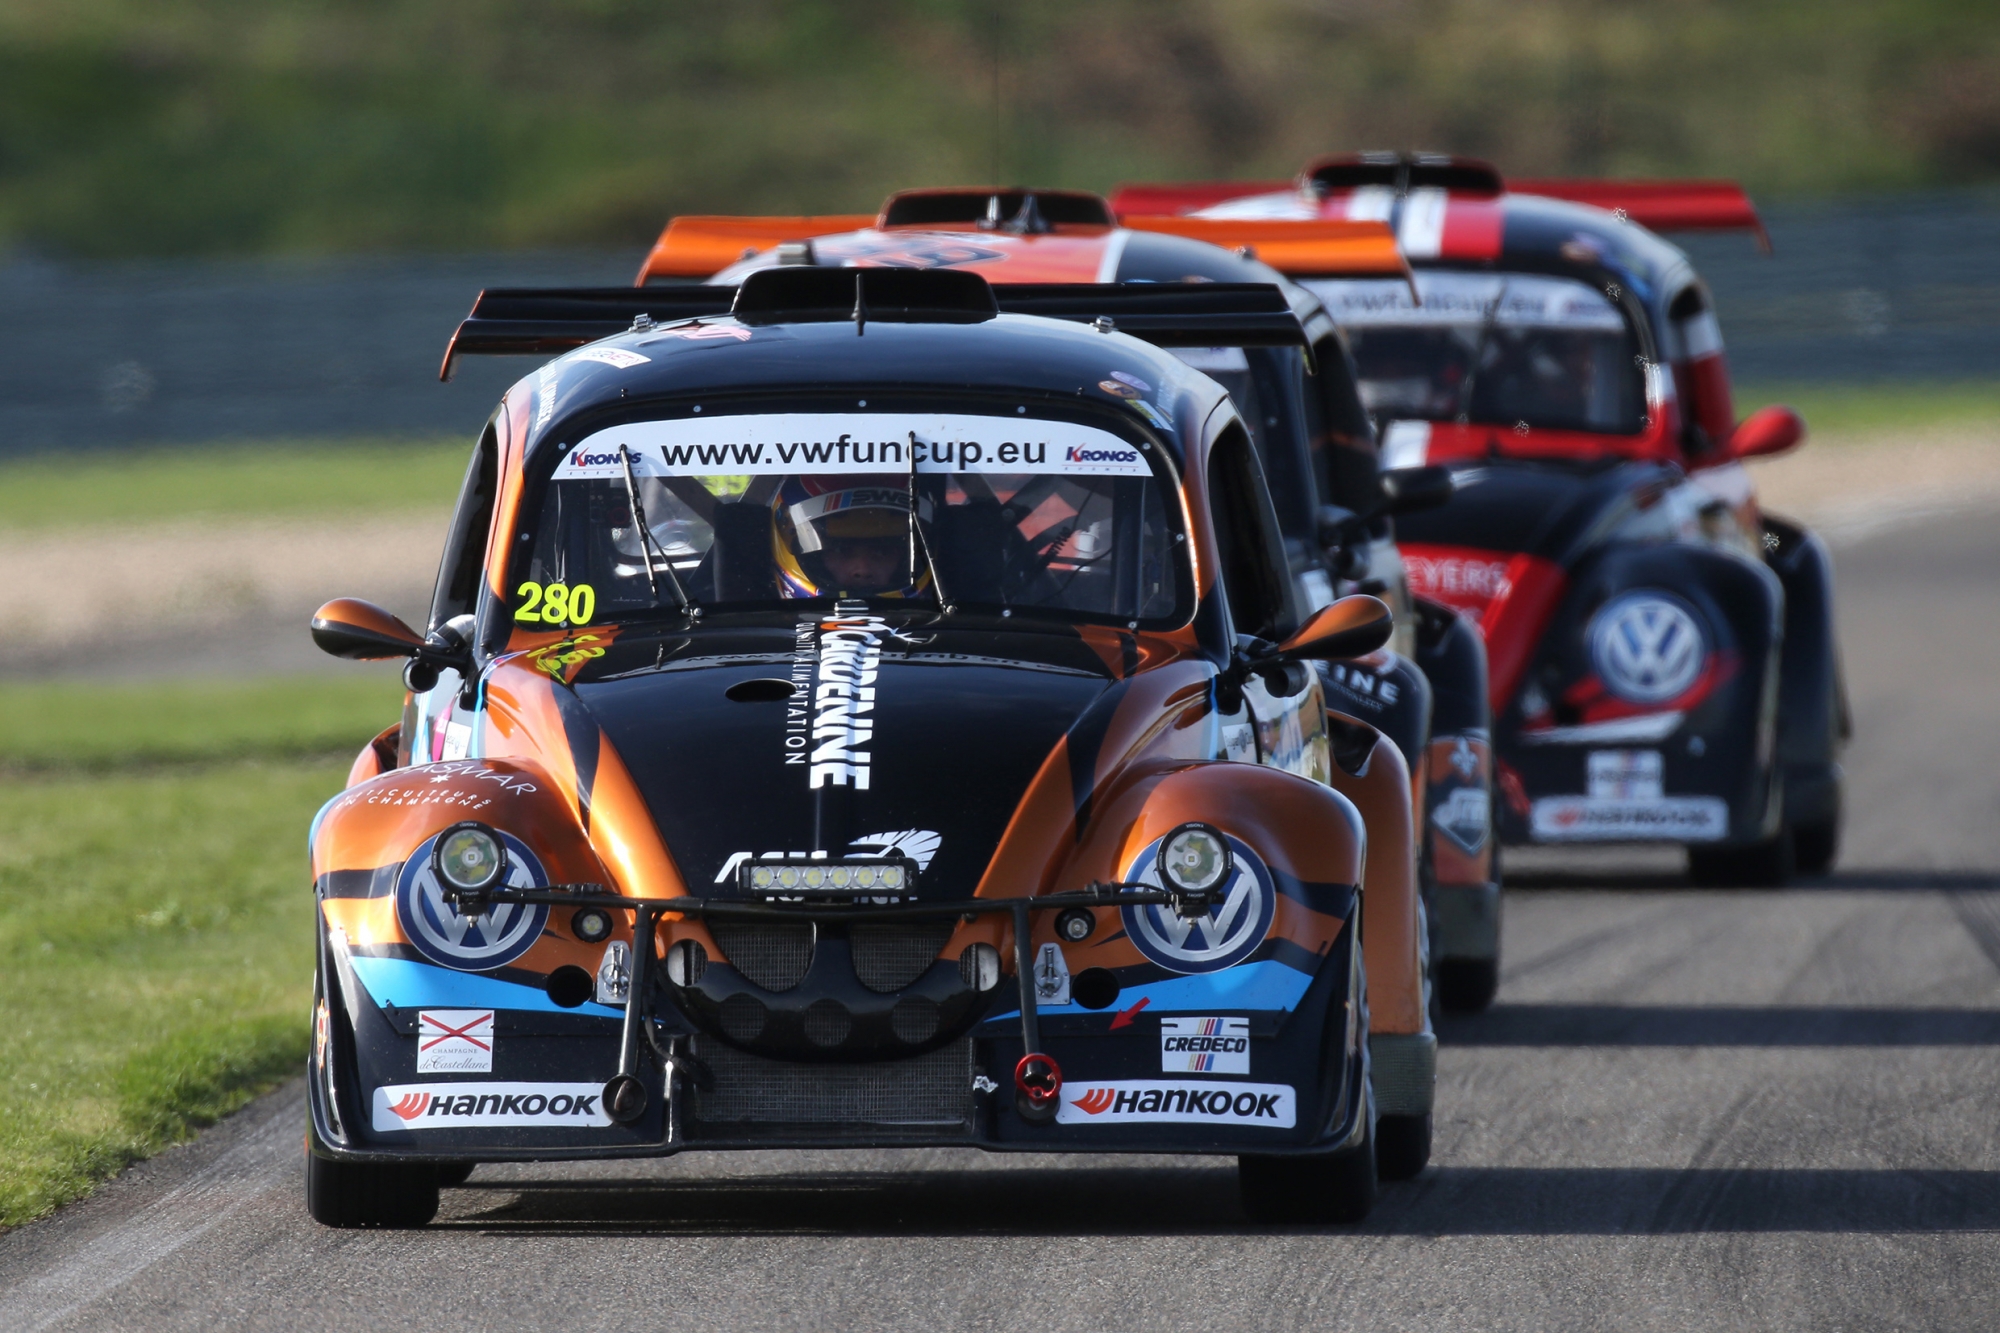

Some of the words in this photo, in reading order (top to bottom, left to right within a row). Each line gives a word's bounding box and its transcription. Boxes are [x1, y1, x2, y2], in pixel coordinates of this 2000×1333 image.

[661, 434, 1046, 471] www.vwfuncup.eu
[1065, 442, 1138, 463] KRONOS
[514, 581, 596, 625] 280
[785, 656, 815, 765] ALIMENTATION
[367, 795, 484, 811] CHAMPAGNE
[1163, 1036, 1248, 1054] CREDECO
